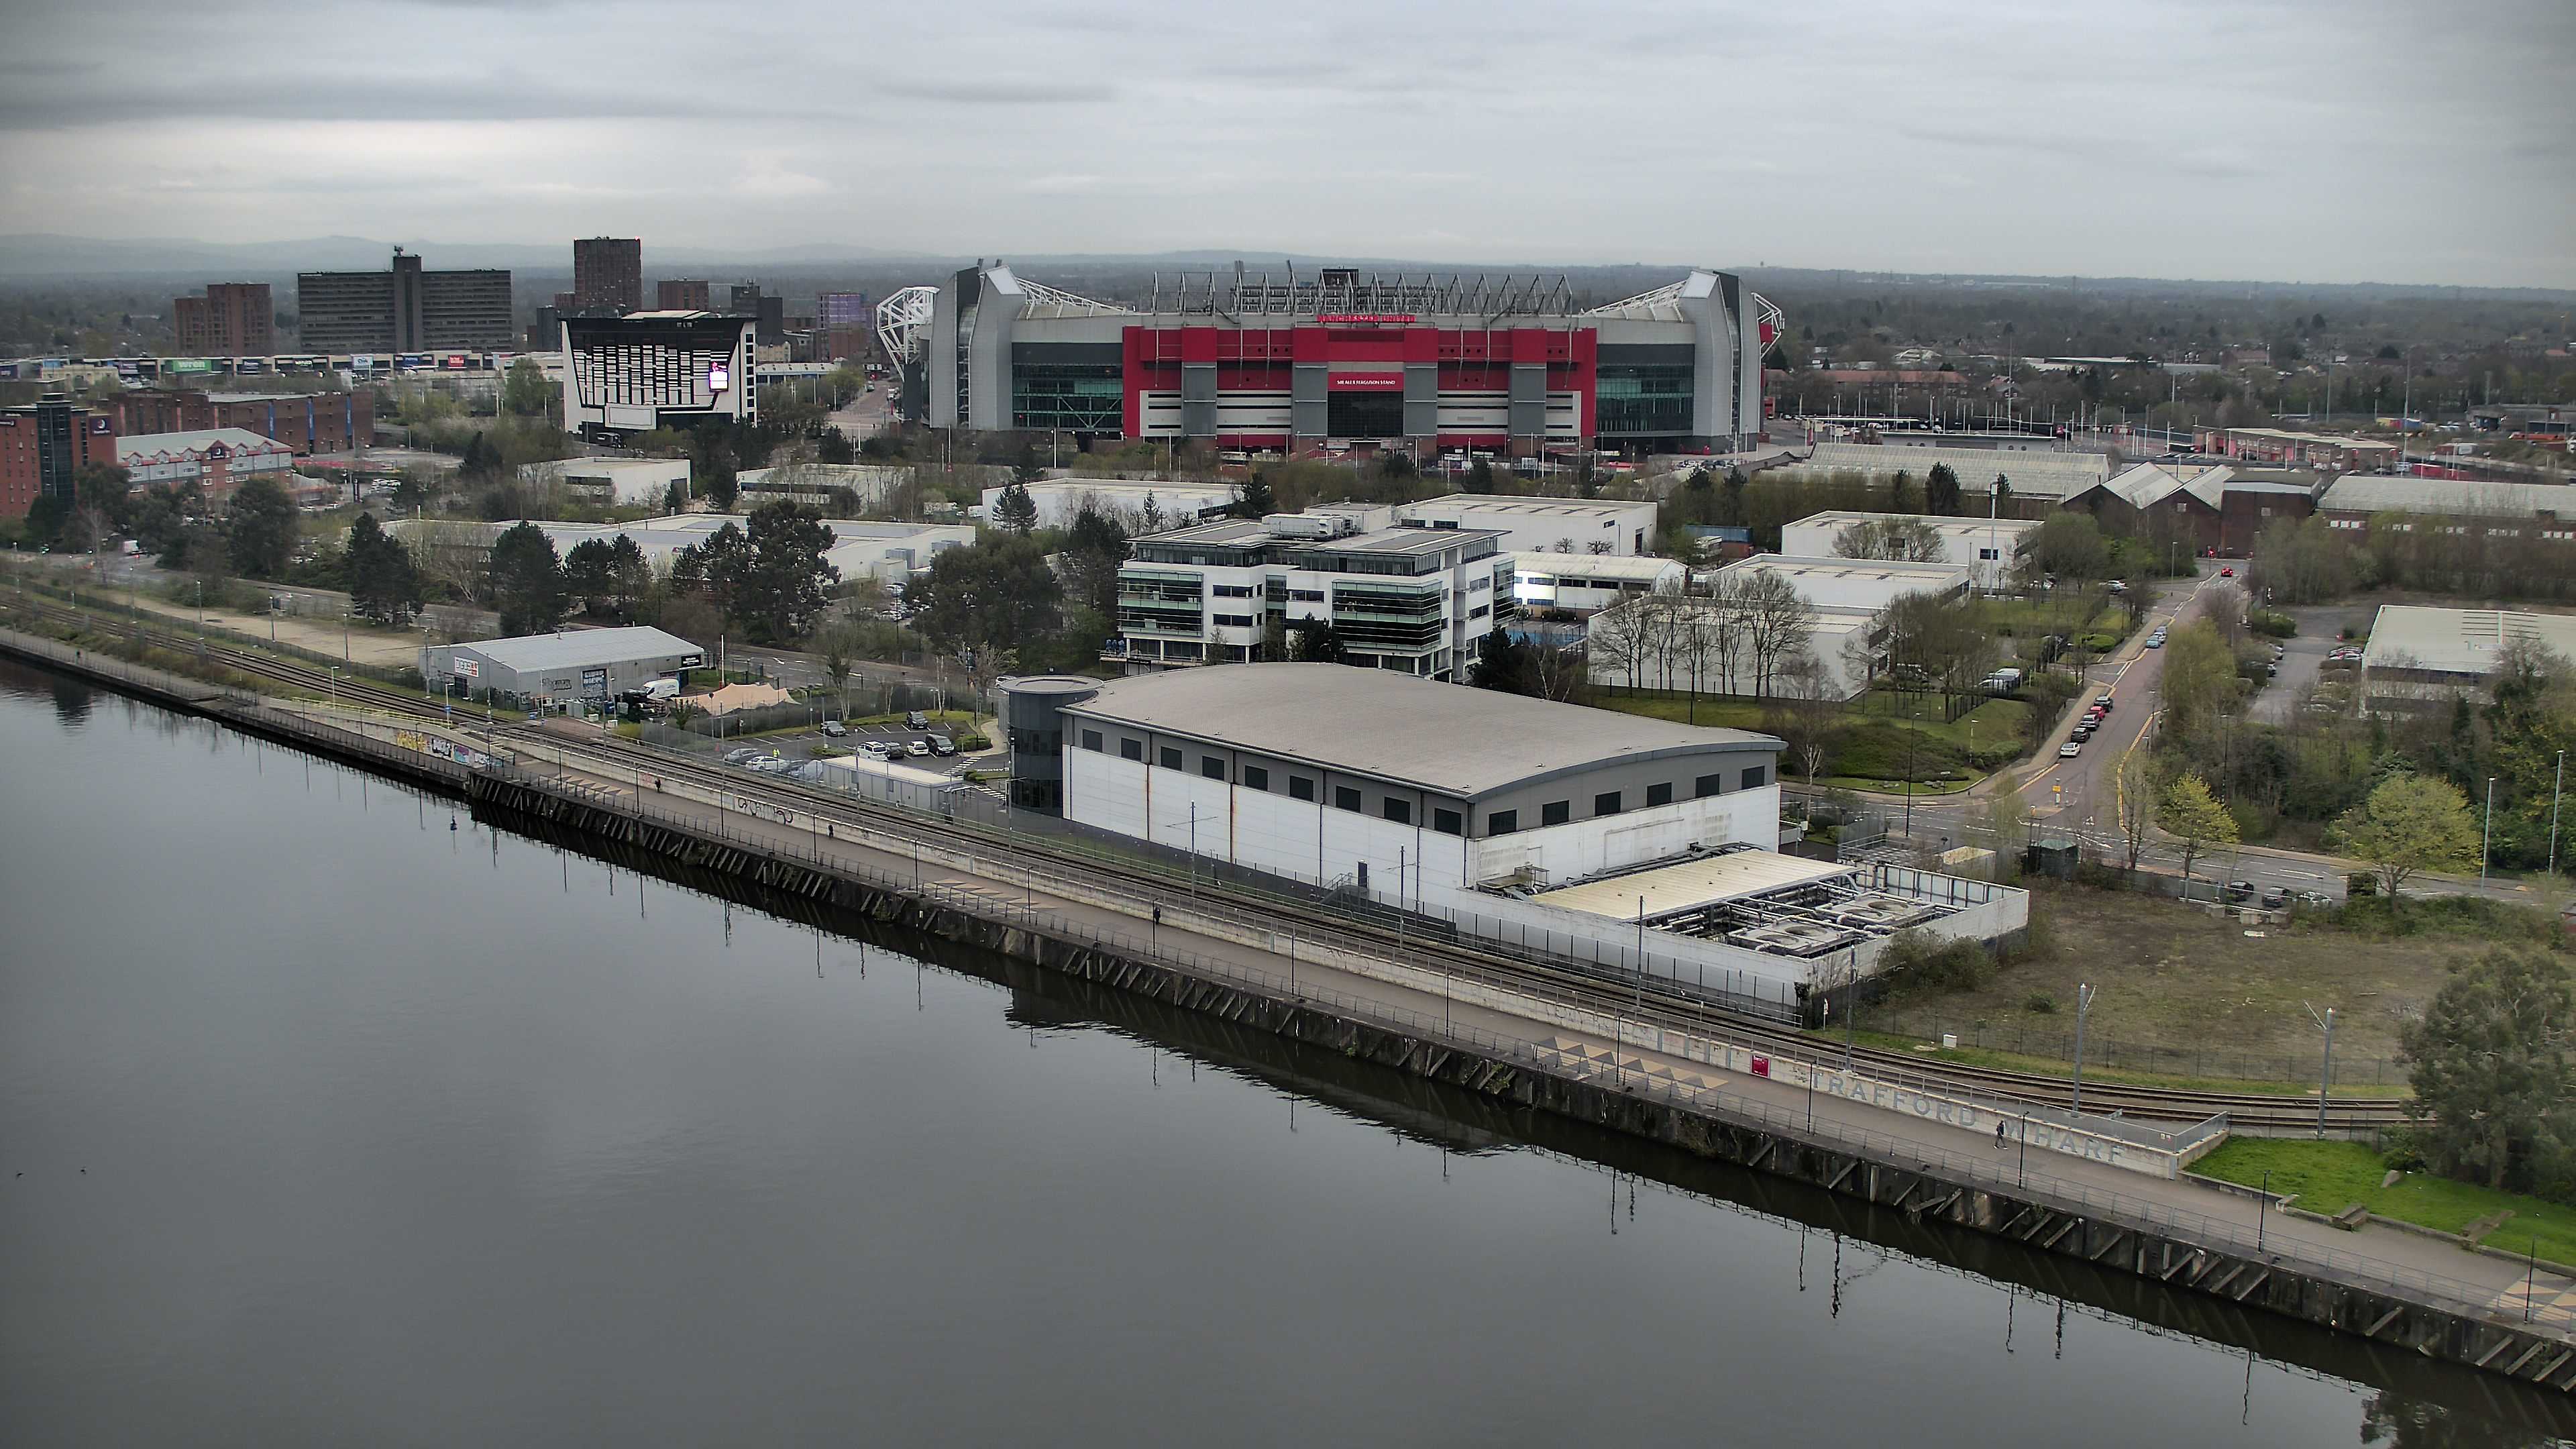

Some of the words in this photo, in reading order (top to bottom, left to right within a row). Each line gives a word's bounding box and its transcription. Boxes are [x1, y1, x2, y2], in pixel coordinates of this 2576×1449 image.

[1317, 314, 1379, 323] MANCHESTER
[1381, 315, 1416, 323] UNITED
[1810, 1071, 1976, 1127] TRAFFORD
[2003, 1120, 2126, 1162] WHARF
